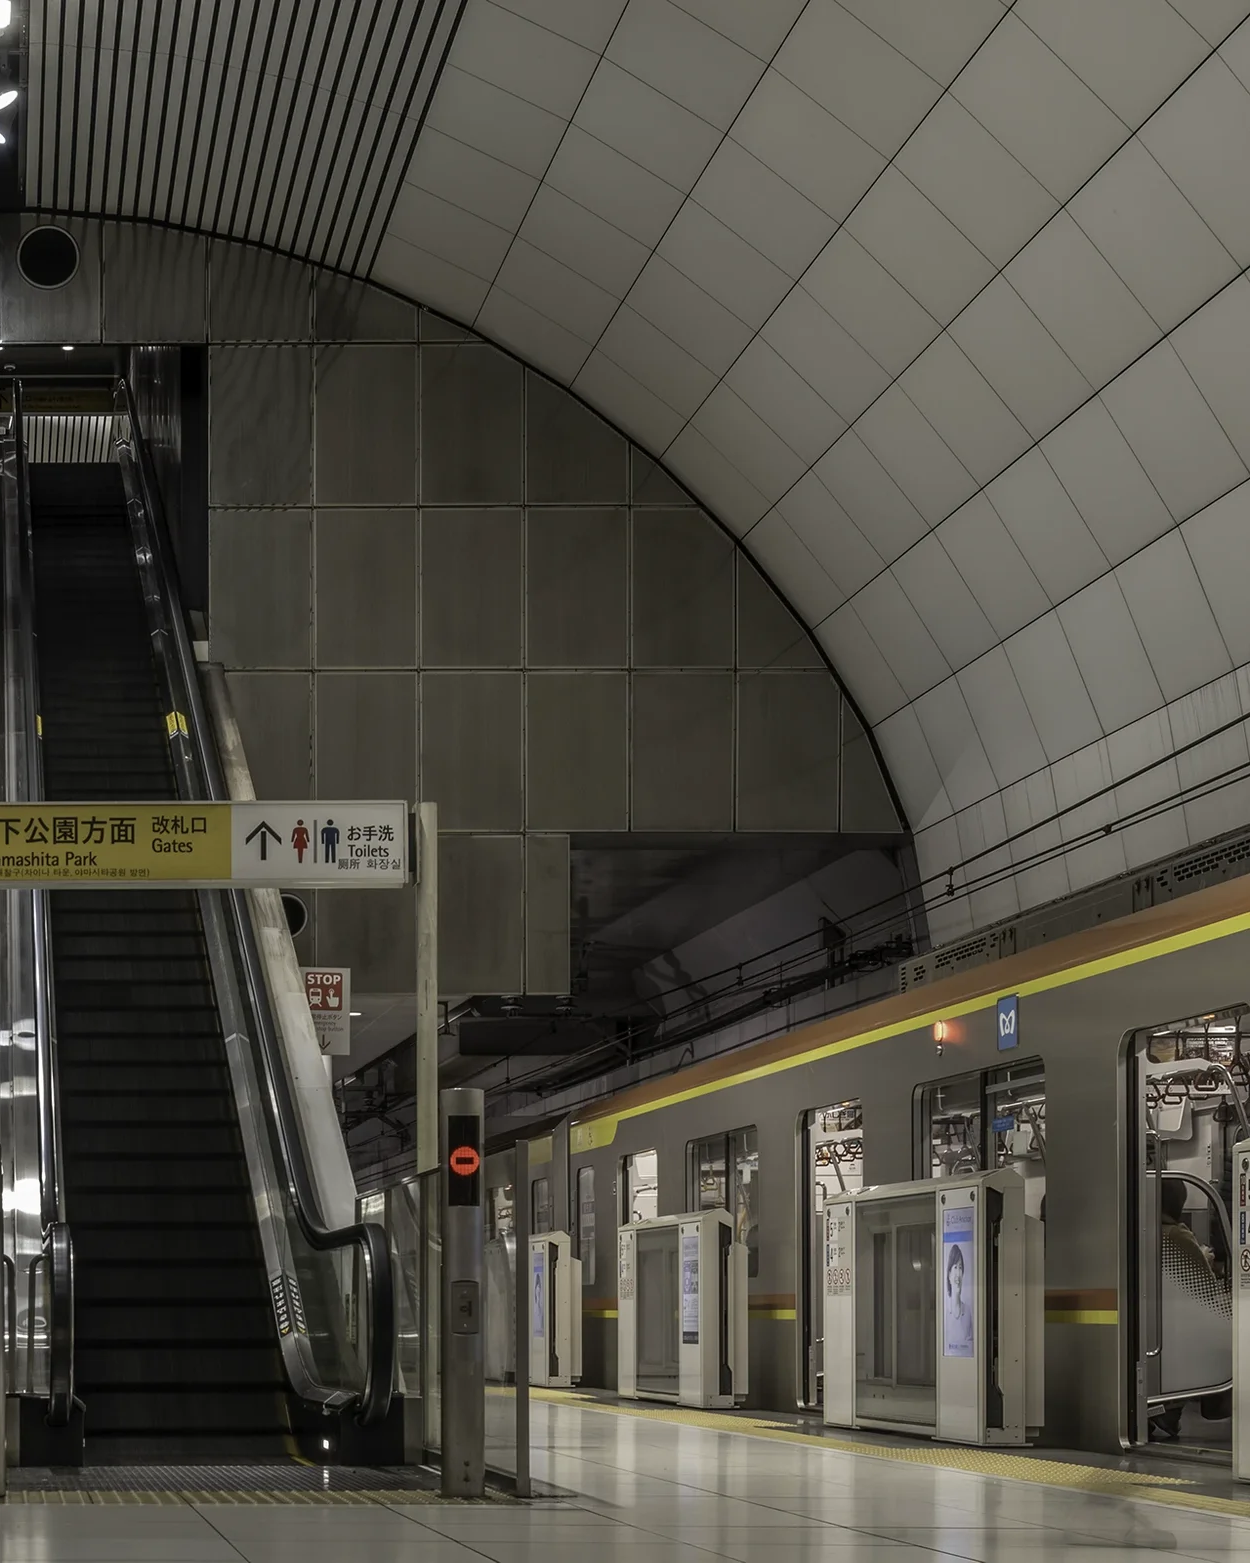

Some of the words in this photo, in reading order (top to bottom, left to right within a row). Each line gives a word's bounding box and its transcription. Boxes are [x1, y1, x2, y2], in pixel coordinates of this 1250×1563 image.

[152, 816, 207, 835] 改札口
[347, 825, 394, 841] お手洗
[152, 838, 193, 853] Gates
[347, 844, 390, 857] Toilets
[65, 851, 97, 866] Park
[366, 858, 401, 870] 화장실
[307, 974, 341, 985] STOP
